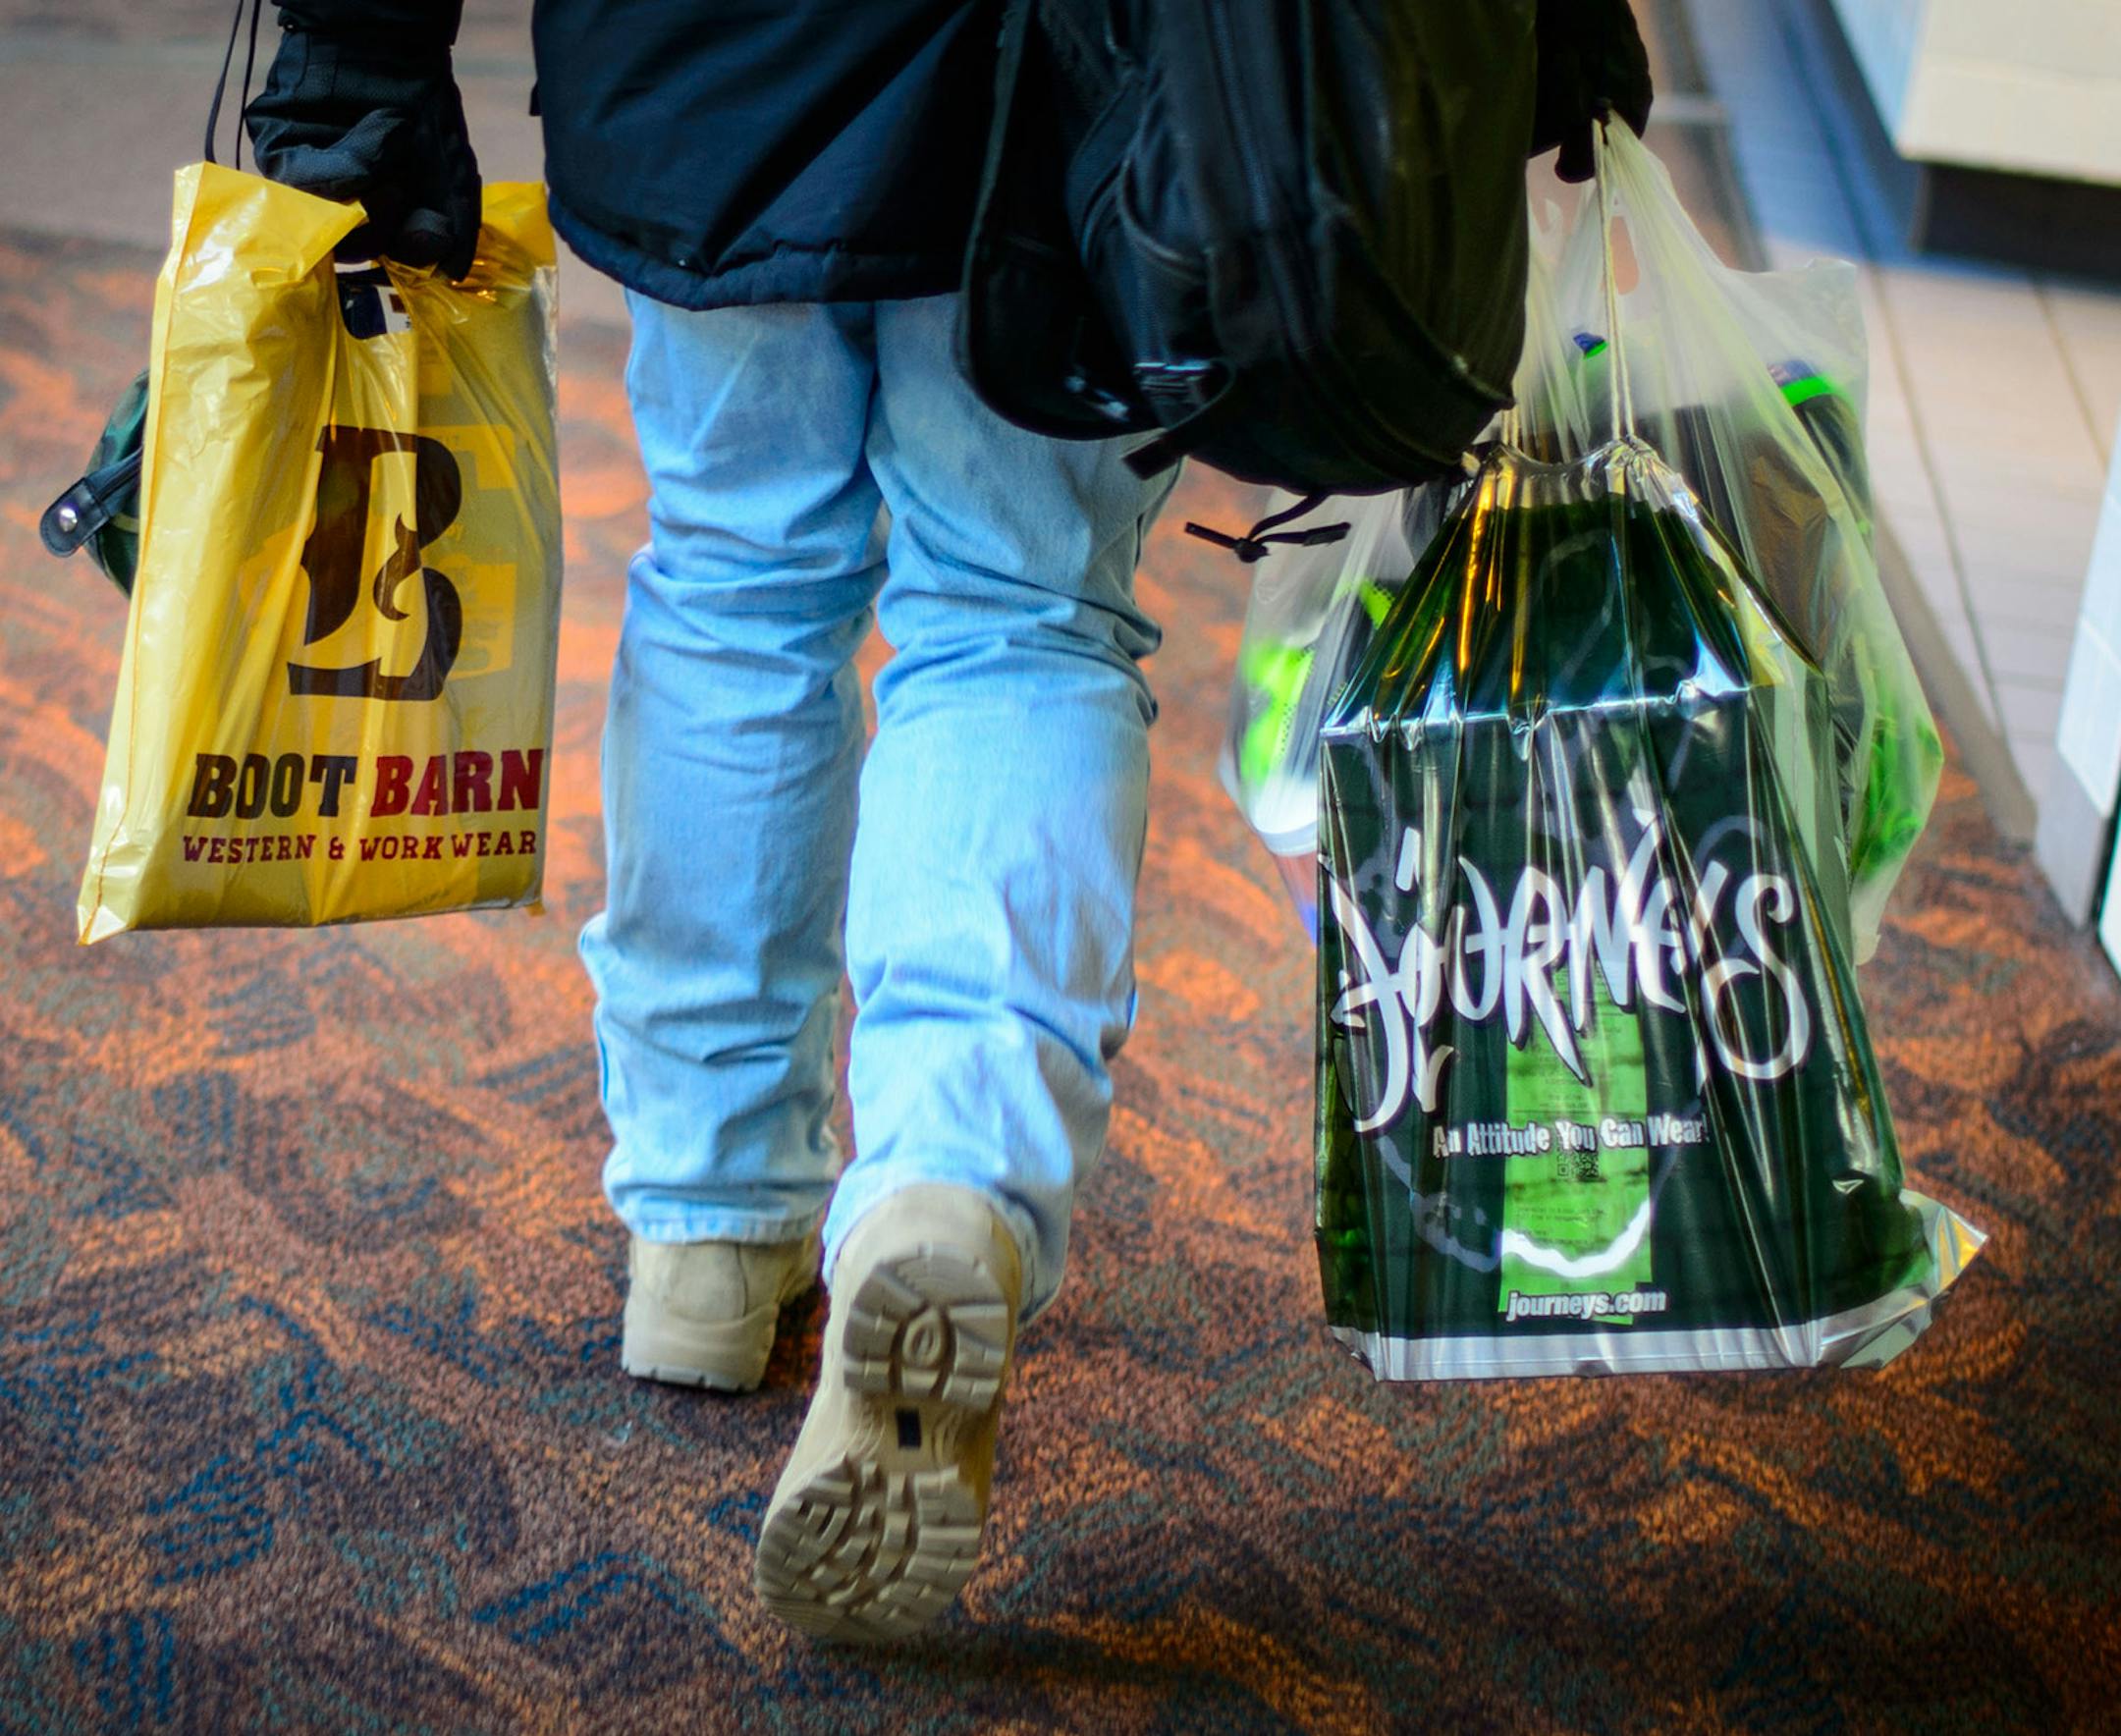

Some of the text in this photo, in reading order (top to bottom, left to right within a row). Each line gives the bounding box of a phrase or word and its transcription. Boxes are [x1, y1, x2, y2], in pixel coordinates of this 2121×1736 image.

[187, 748, 544, 819] BOOT BARN
[183, 831, 536, 863] WESTERN & WORK WEAR
[1433, 1125, 1461, 1158] An
[1467, 1121, 1550, 1156] Attitude
[1555, 1120, 1597, 1151] You
[1600, 1117, 1645, 1148] Can
[1505, 1291, 1667, 1323] journeys.com
